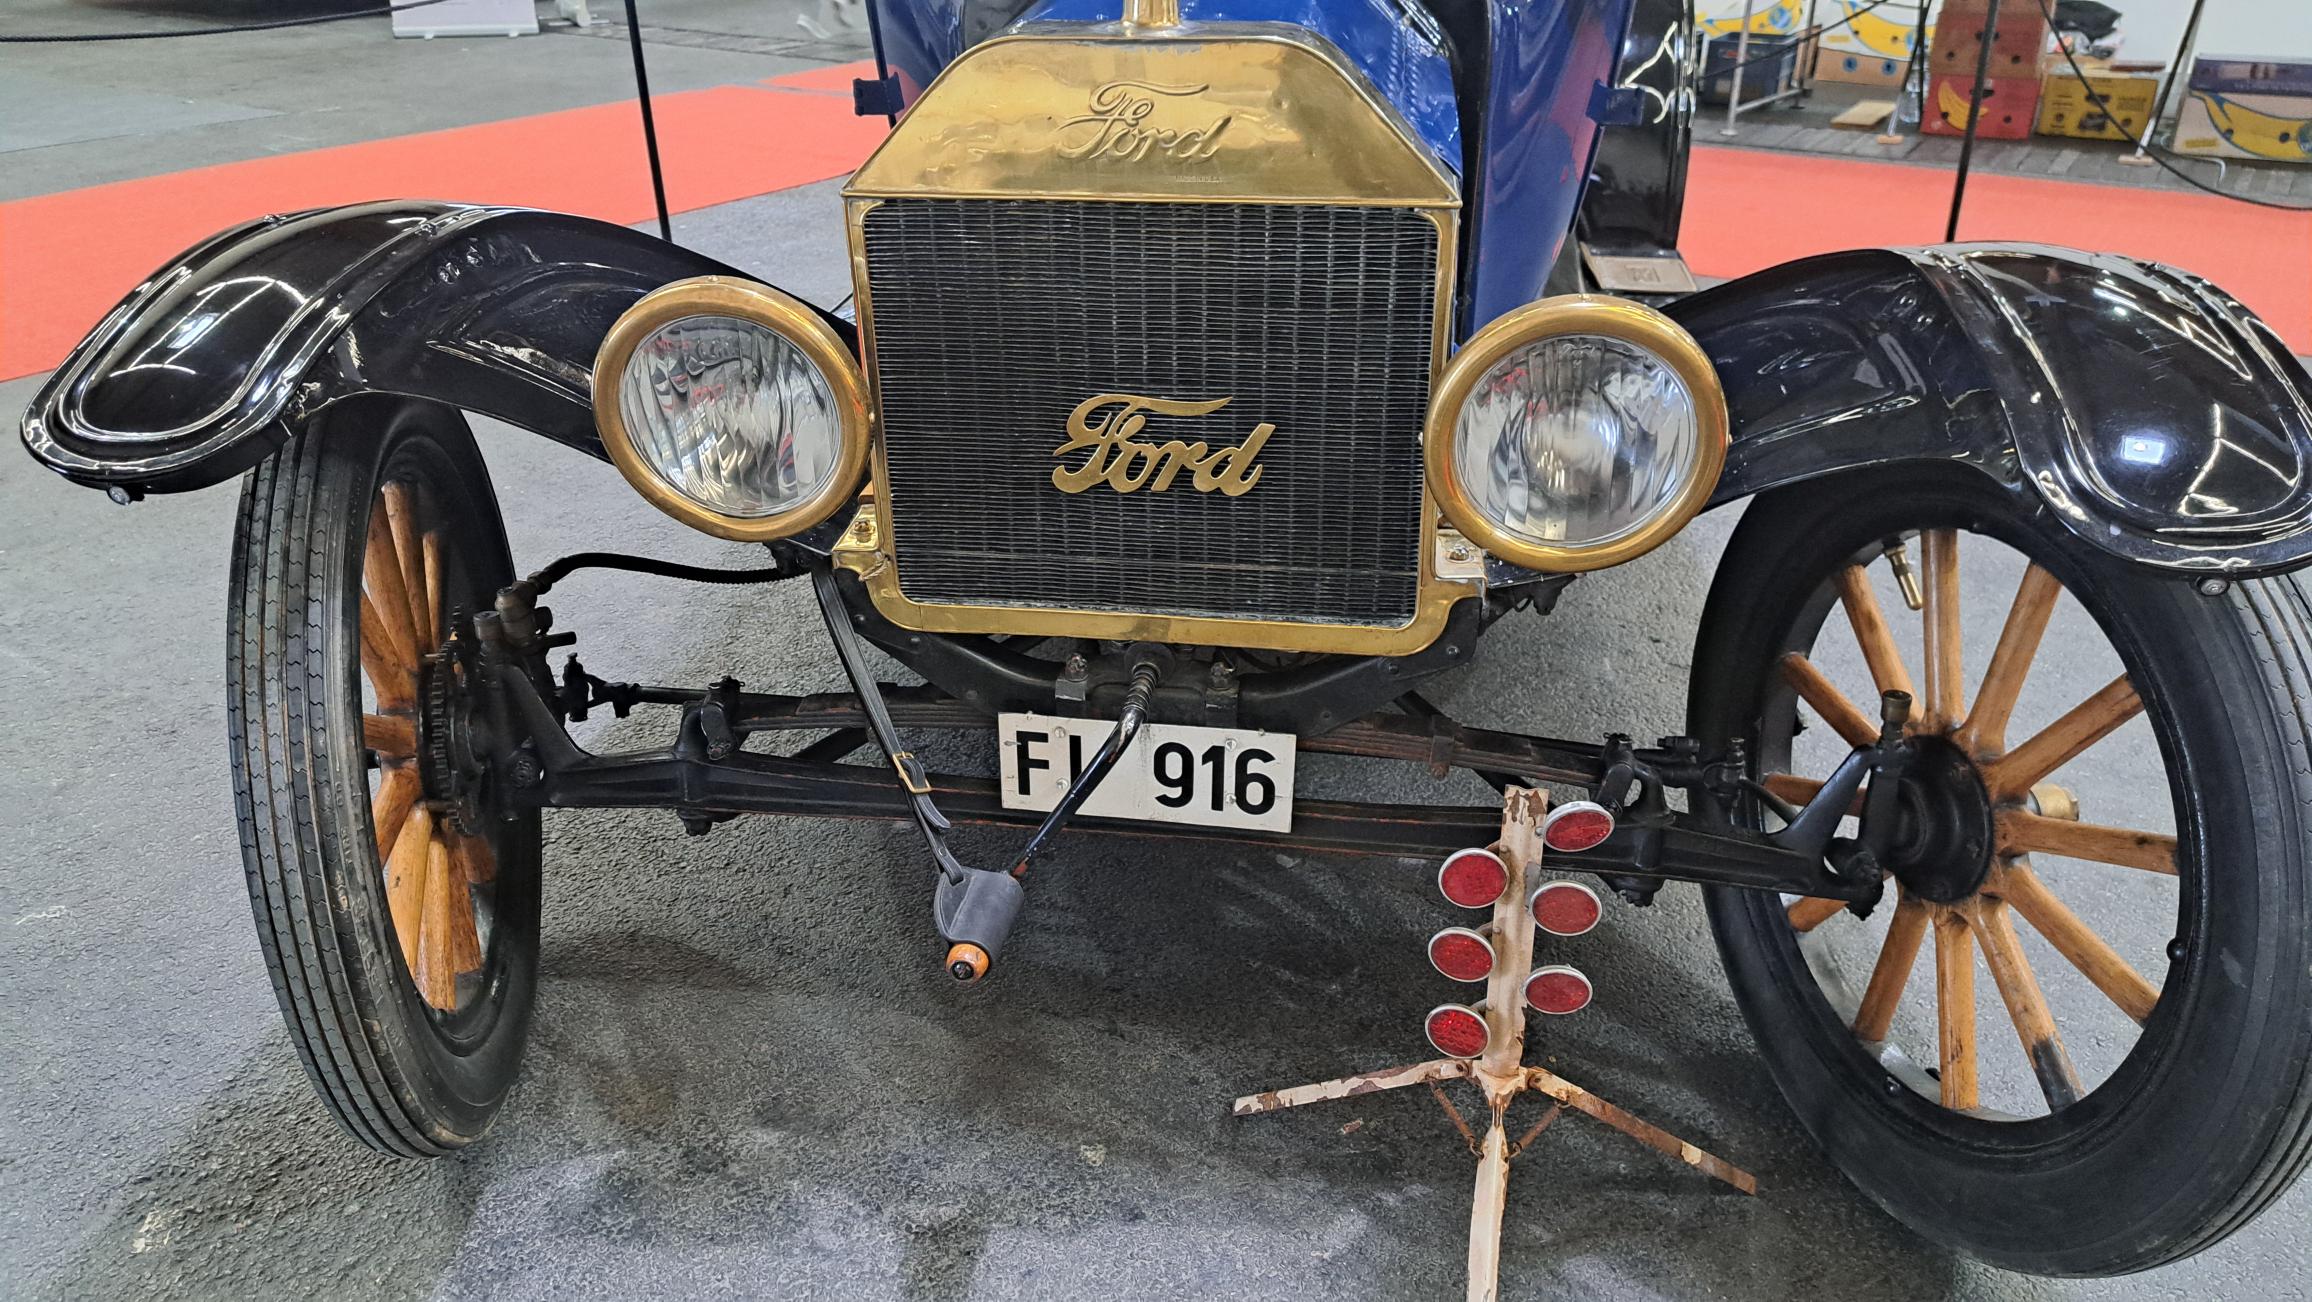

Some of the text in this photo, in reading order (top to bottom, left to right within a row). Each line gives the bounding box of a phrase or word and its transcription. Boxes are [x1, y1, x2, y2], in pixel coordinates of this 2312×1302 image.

[1055, 80, 1232, 162] Ford
[1052, 393, 1276, 497] Ford
[1153, 741, 1276, 815] 916
